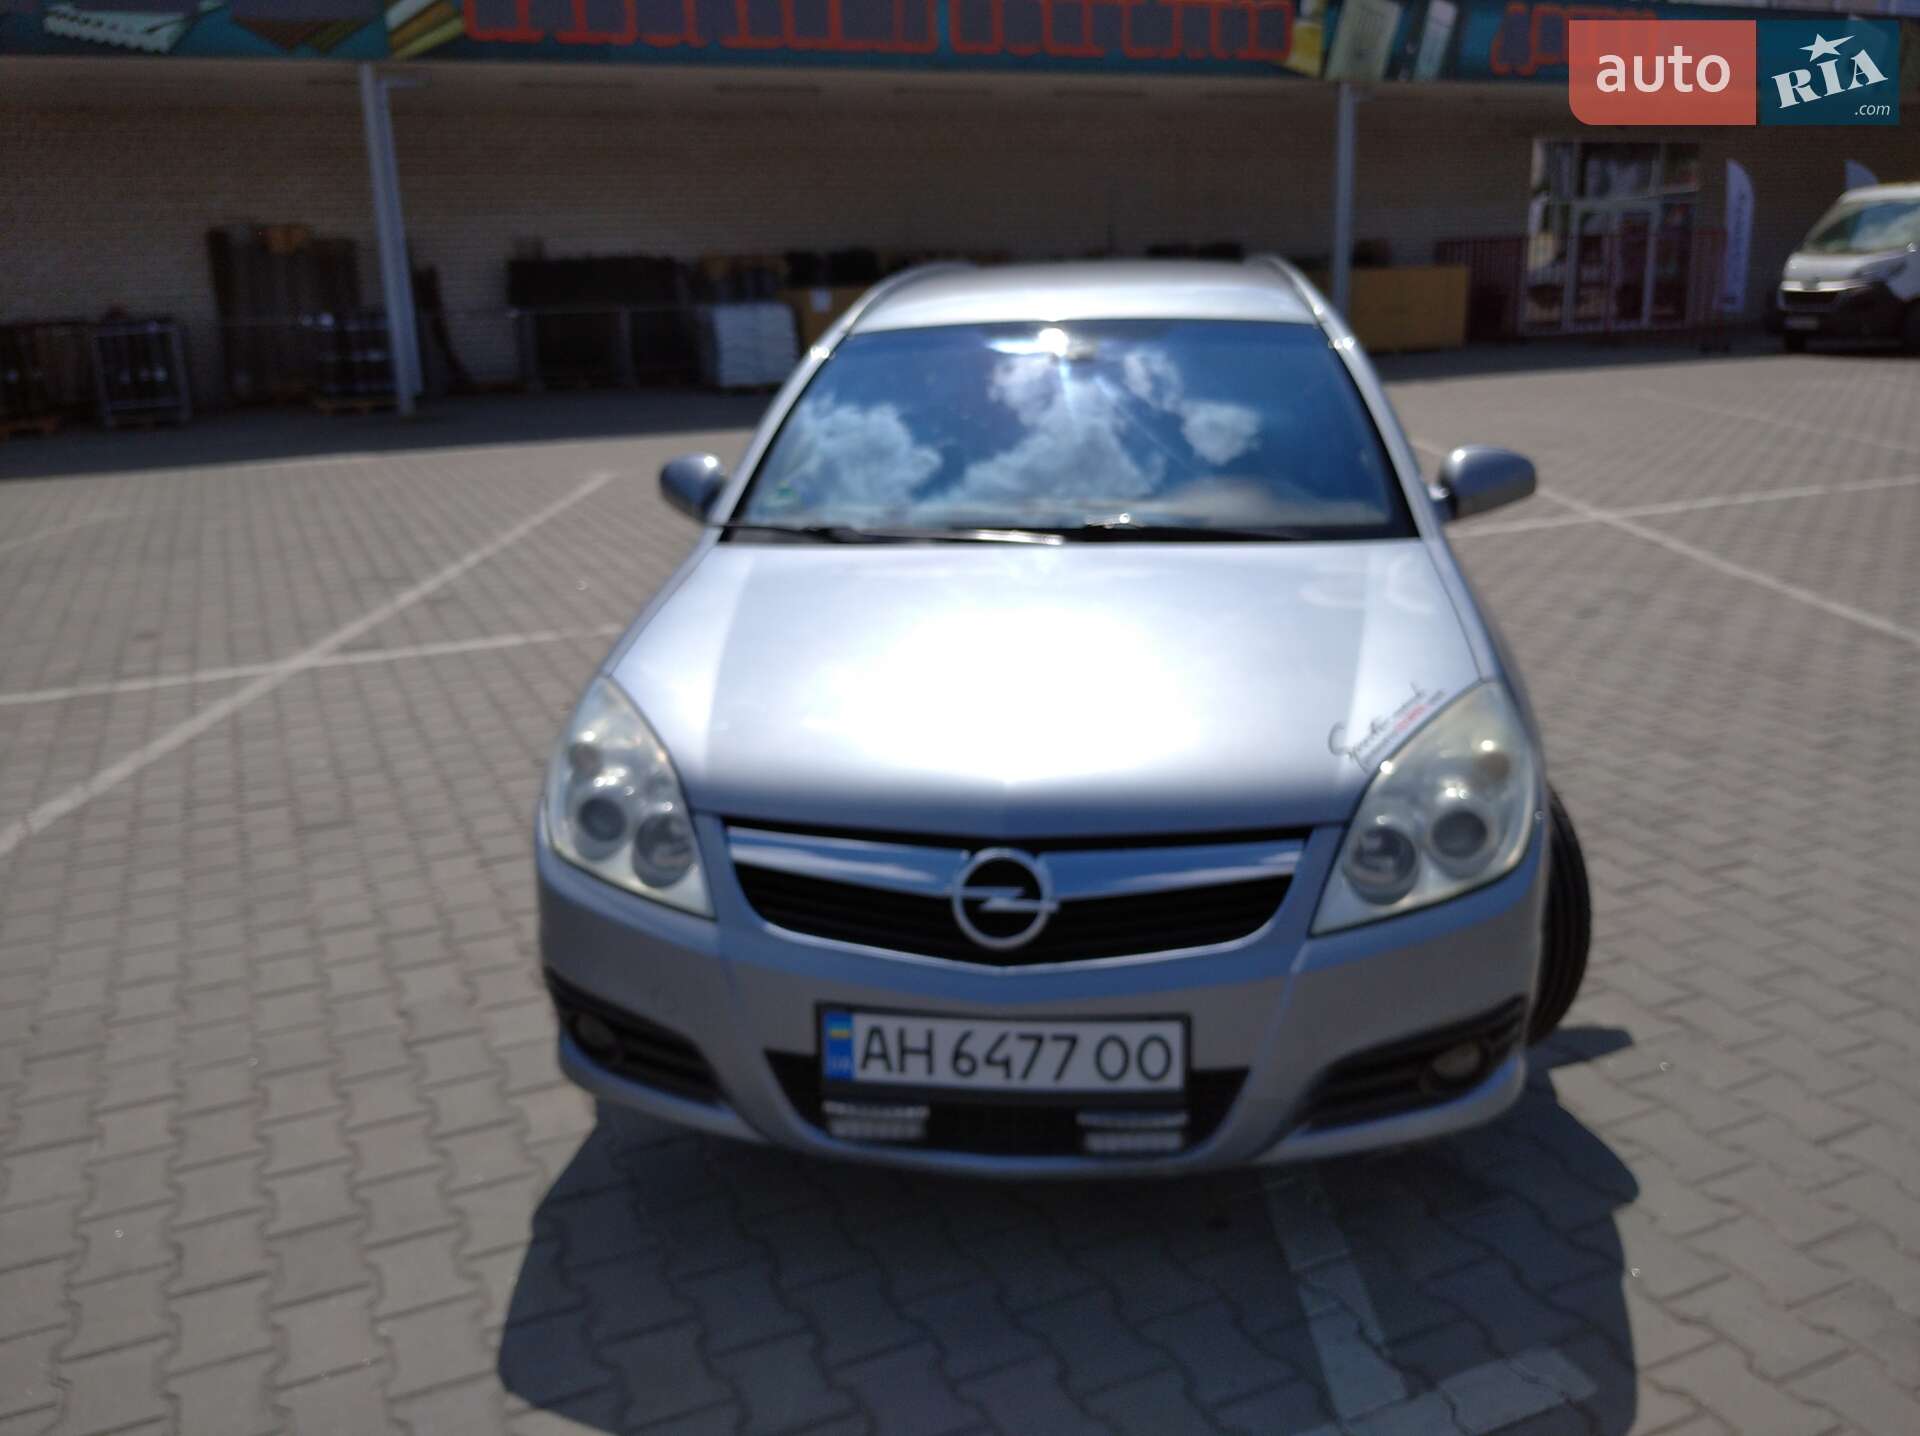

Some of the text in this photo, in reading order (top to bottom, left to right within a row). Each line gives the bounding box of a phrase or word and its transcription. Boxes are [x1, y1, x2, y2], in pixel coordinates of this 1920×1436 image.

[859, 1025, 1173, 1083] AH 6477 OO
